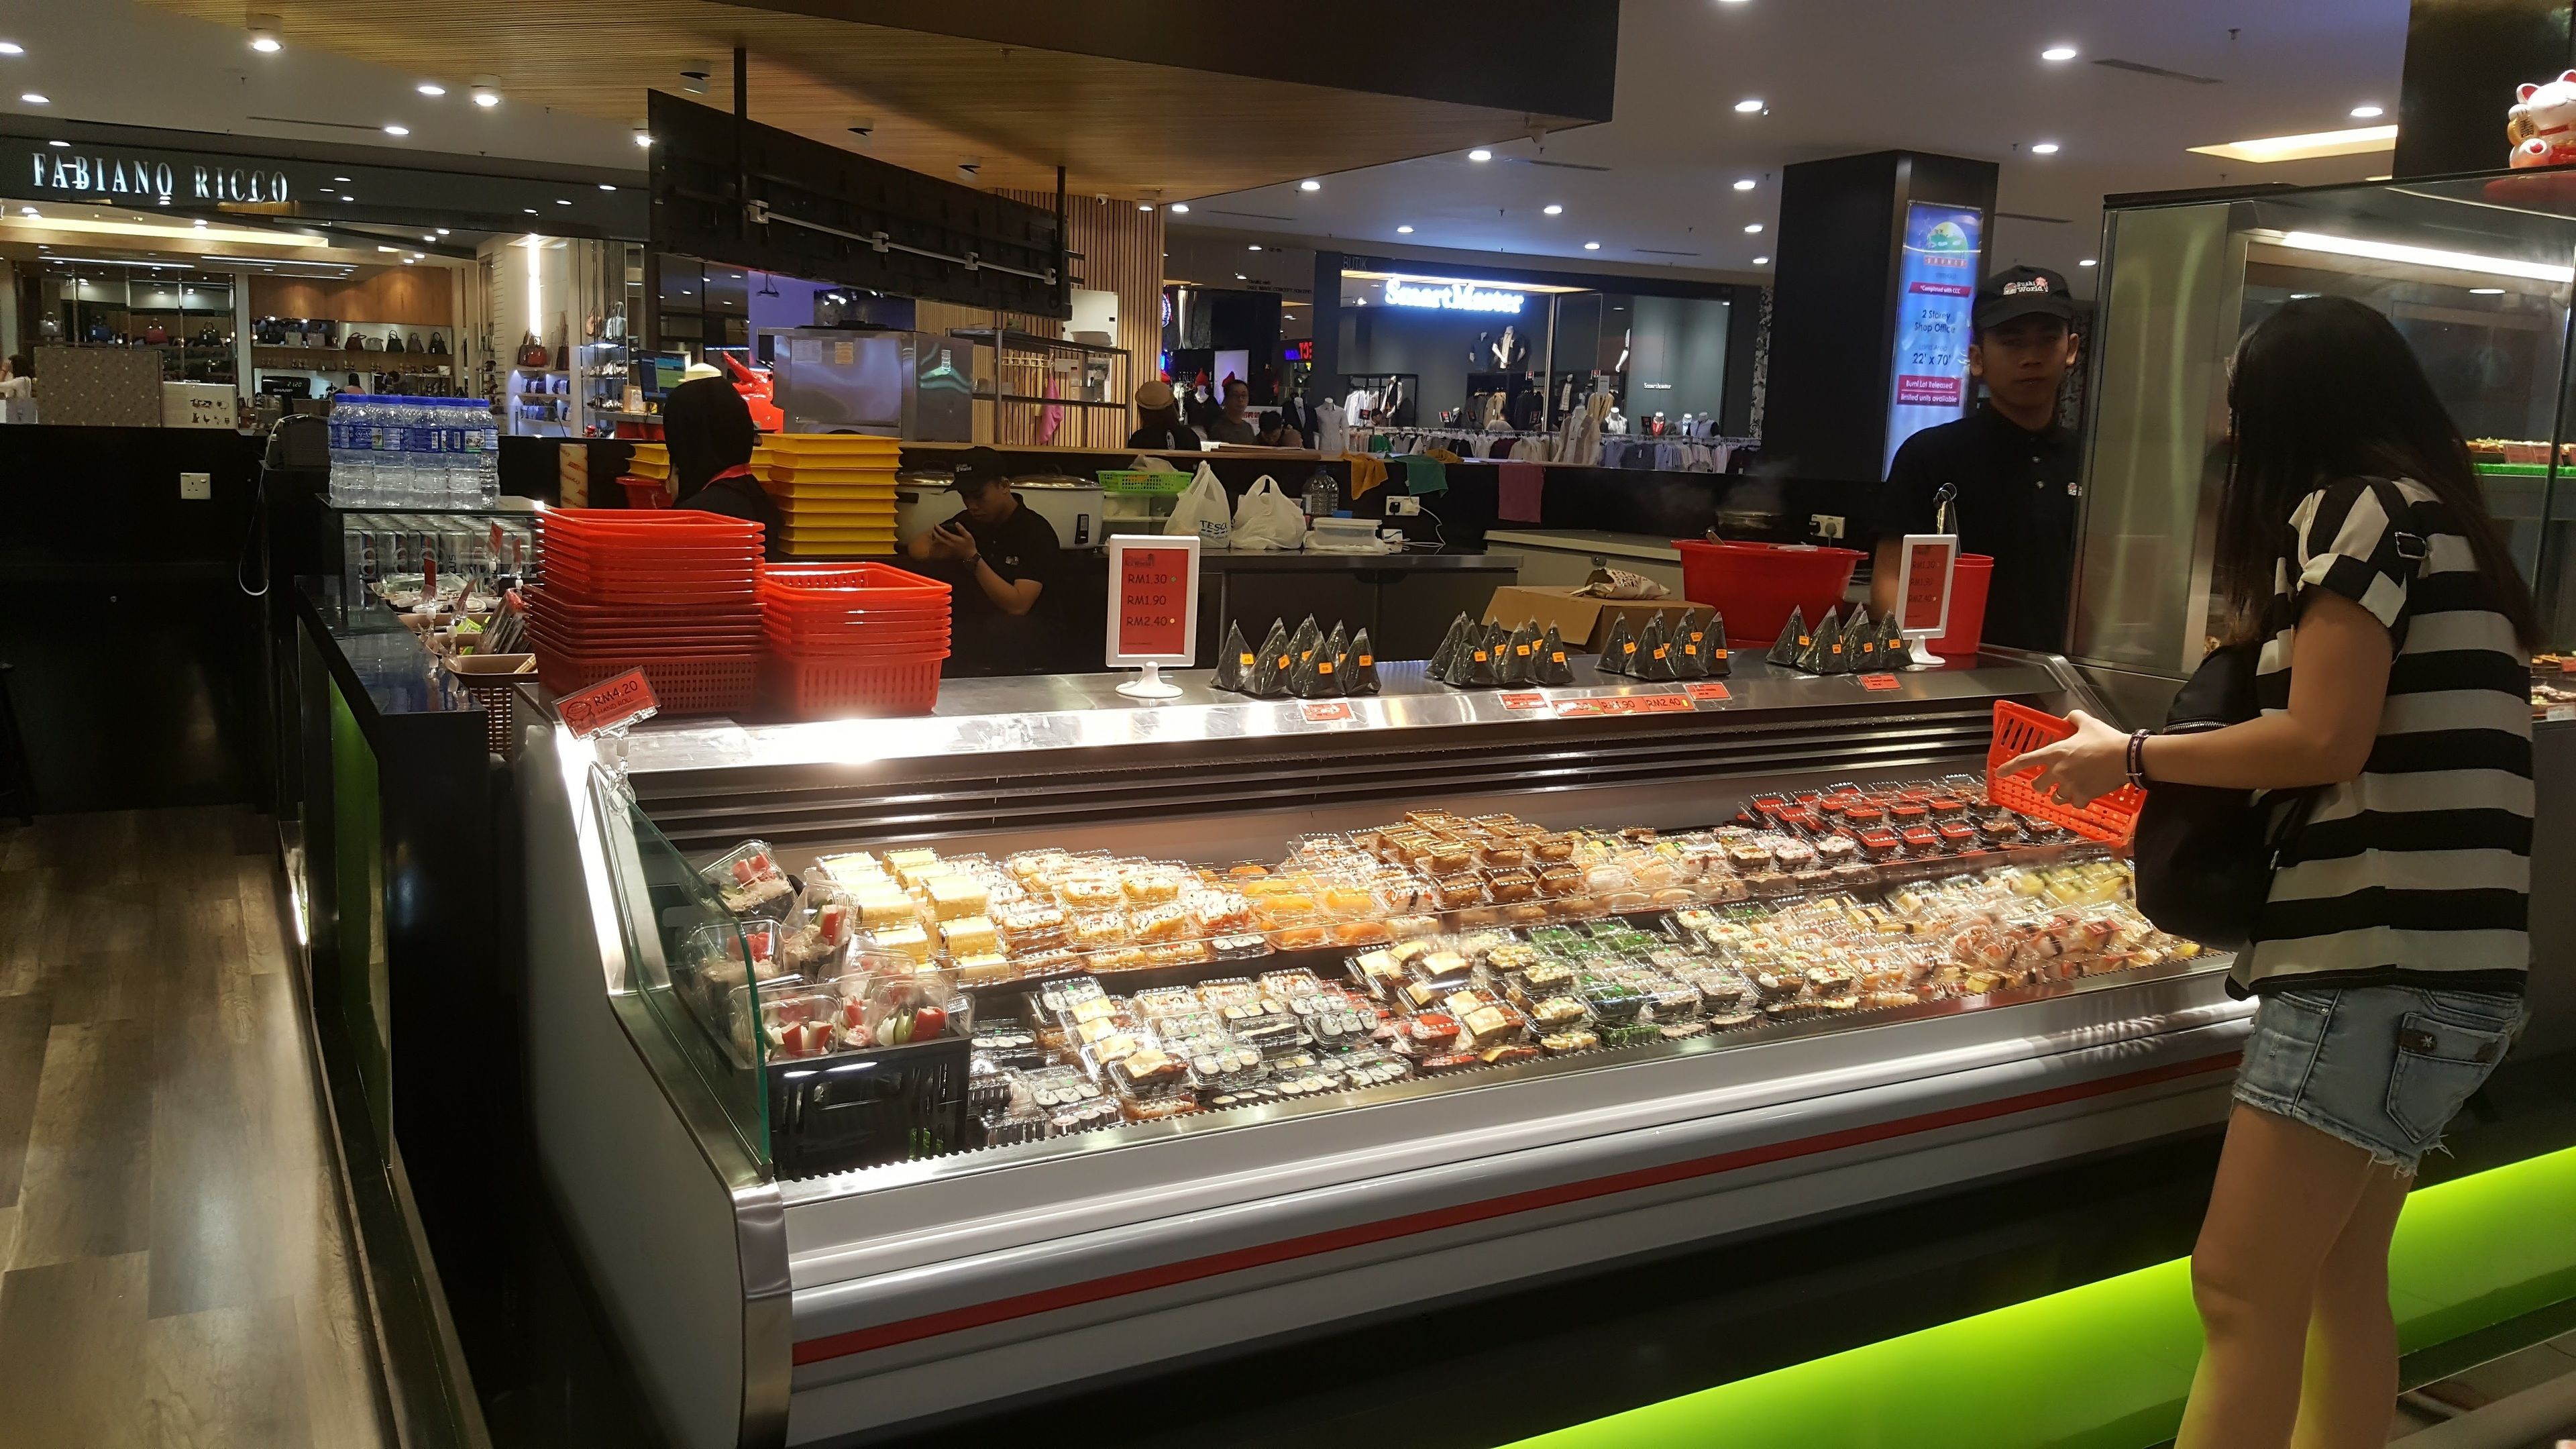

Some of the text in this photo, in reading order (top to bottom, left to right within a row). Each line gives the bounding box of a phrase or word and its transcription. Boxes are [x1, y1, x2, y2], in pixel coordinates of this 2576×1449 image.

[32, 152, 288, 203] FABIANO RICCO
[1342, 256, 1368, 269] BUTIK
[1922, 309, 1951, 320] 2 Storey
[1915, 322, 1955, 333] Shop Office
[1929, 381, 1953, 389] Released
[1128, 574, 1167, 584] RM1.30
[1127, 595, 1167, 605] RM1.90
[1126, 616, 1167, 627] RM2.40
[593, 680, 638, 706] RM4.20
[1646, 698, 1681, 708] RM2.40
